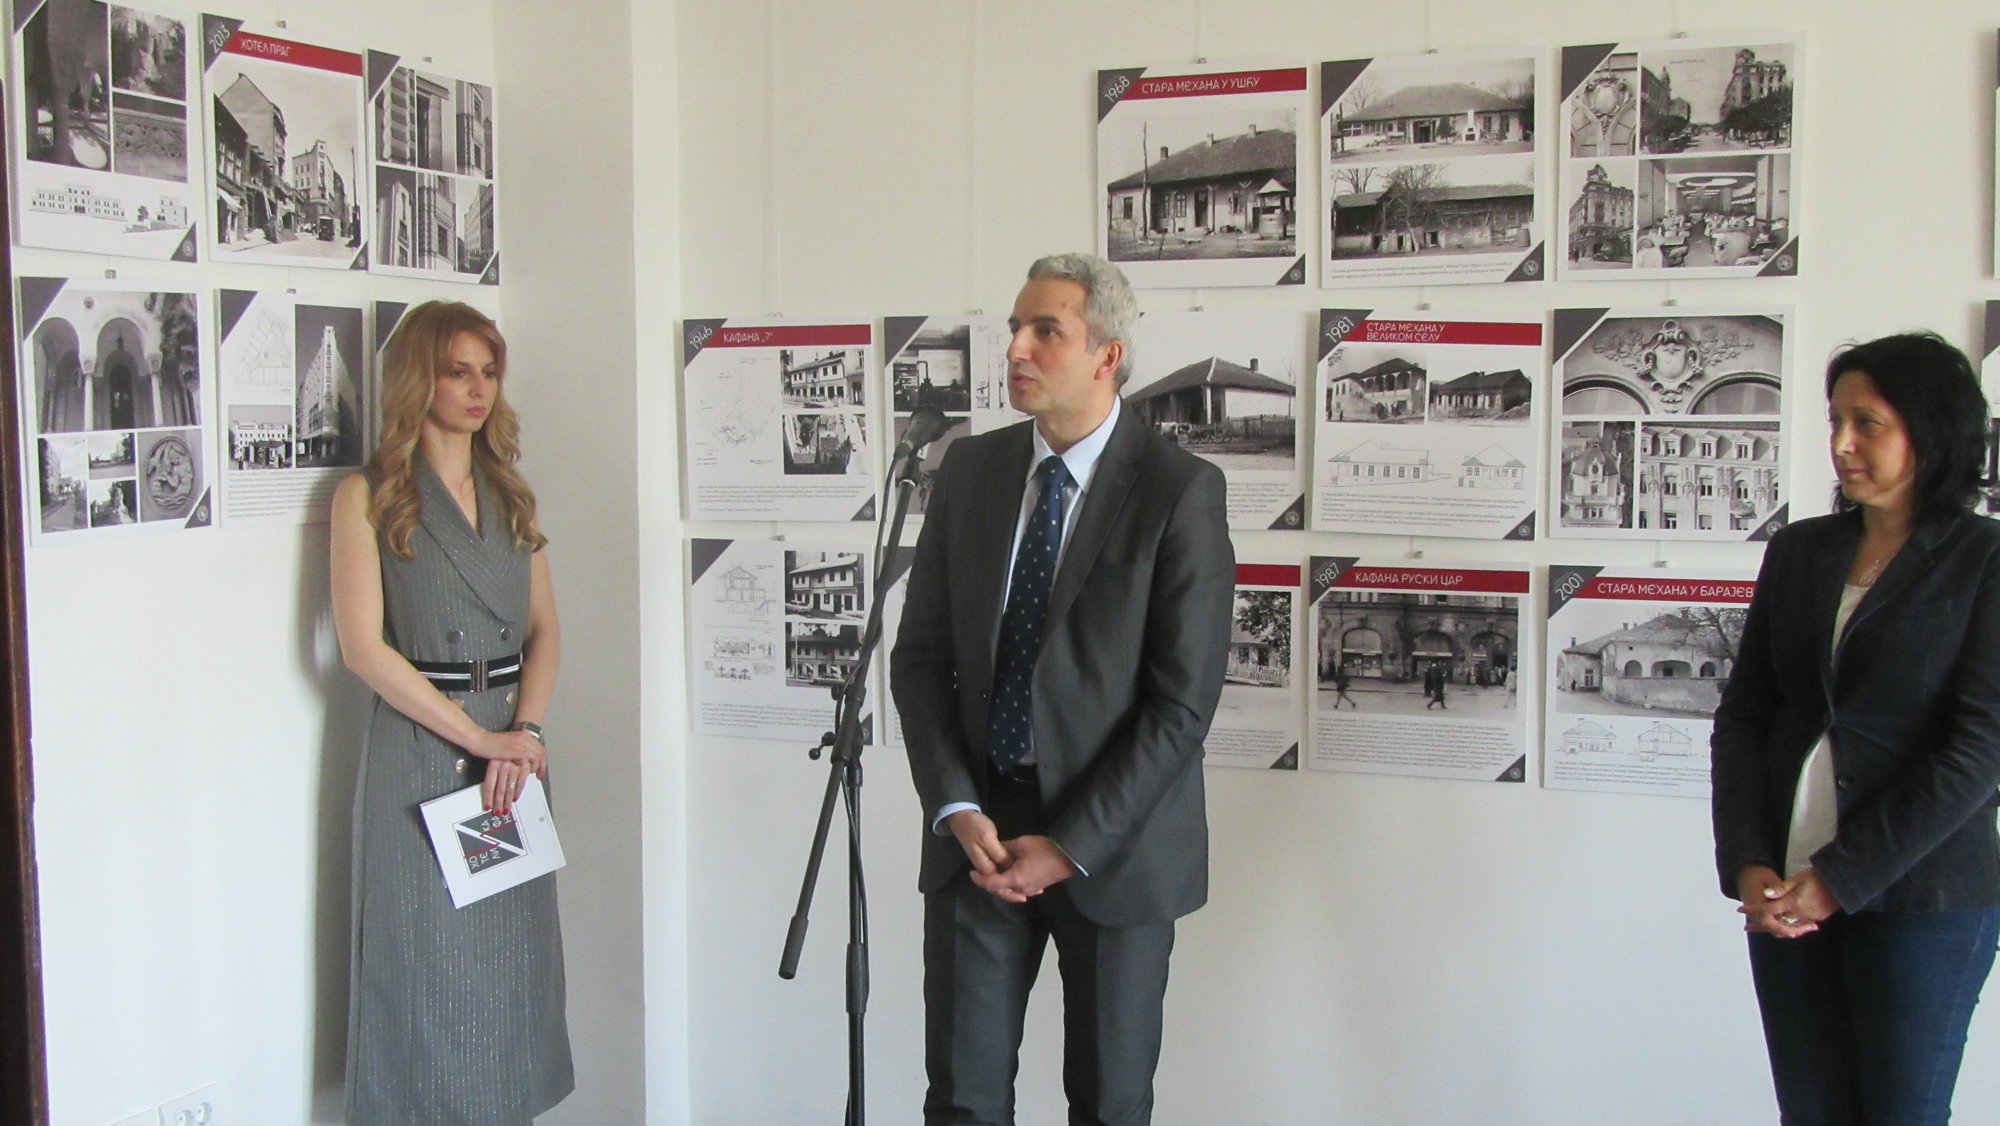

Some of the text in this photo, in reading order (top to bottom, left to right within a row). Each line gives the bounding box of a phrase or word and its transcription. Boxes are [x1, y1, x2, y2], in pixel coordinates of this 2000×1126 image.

[209, 24, 231, 54] 2013
[240, 38, 292, 57] ХОТЕЛ ПРАГ
[1104, 75, 1130, 103] 1968
[1141, 82, 1174, 94] СТАРА
[1176, 80, 1219, 92] МЕХАНА
[1221, 79, 1229, 90] У
[1325, 315, 1354, 343] 1981
[1366, 322, 1446, 333] СТАРА МЕХАНА У
[1366, 332, 1441, 342] ВЕЛИКОМ СЕЛУ
[689, 326, 713, 350] 1946
[723, 332, 760, 344] КАФАНА
[1315, 562, 1341, 589] 1987
[1355, 572, 1463, 586] КАФАНА РУСКИ ЦАР
[1555, 572, 1585, 601] 2001
[1597, 583, 1754, 598] СТАРА МЕХАНА У БАРАЈЕВ
